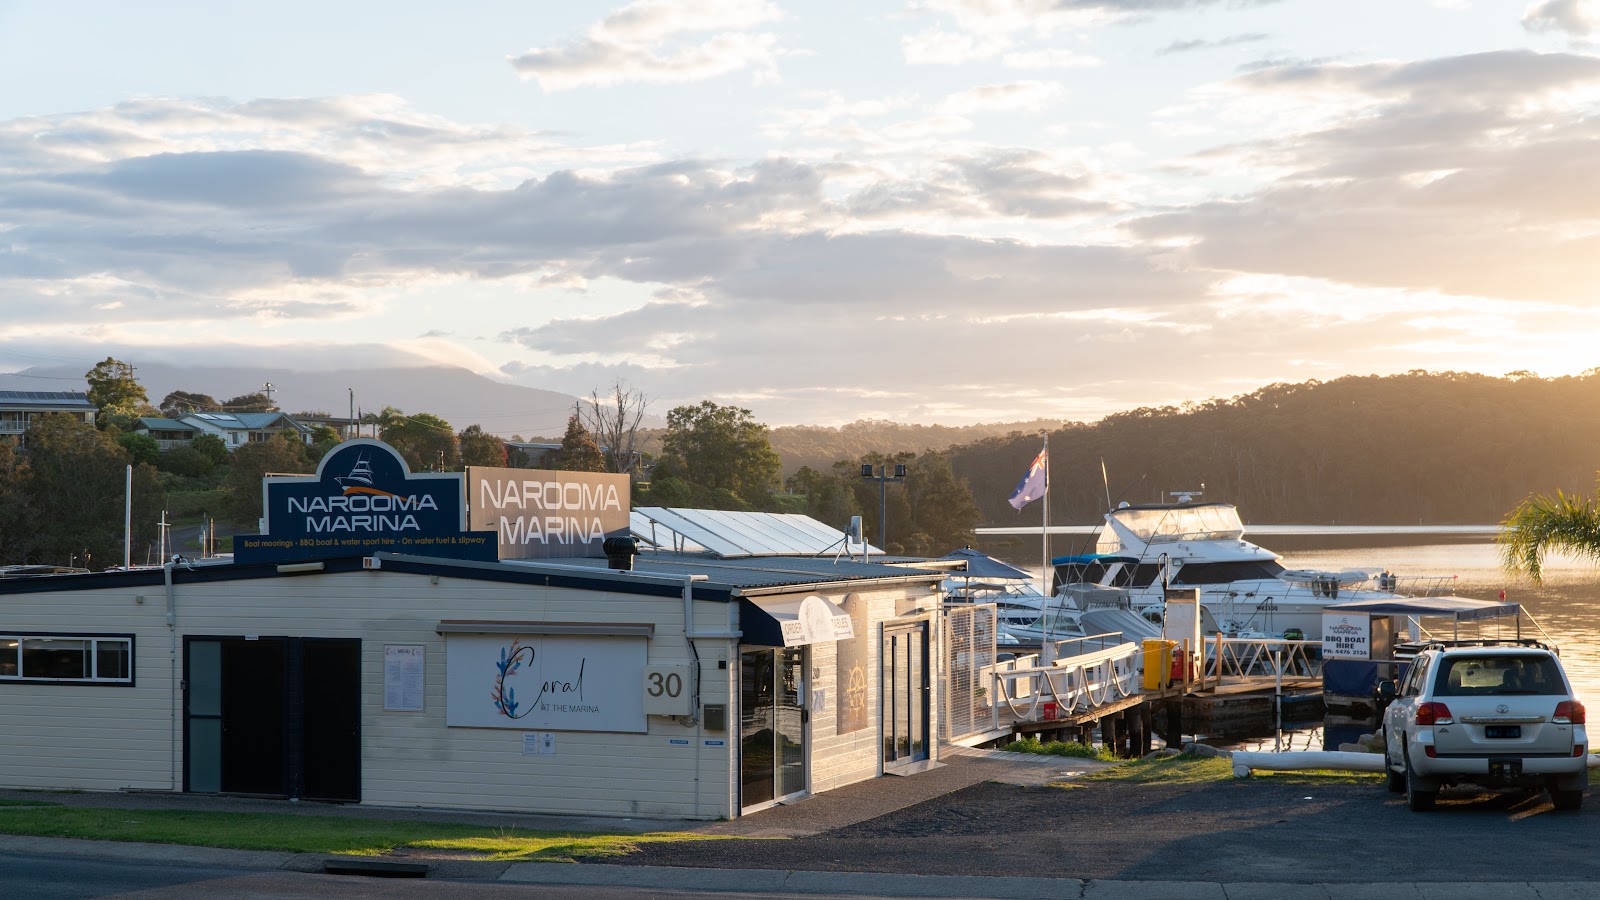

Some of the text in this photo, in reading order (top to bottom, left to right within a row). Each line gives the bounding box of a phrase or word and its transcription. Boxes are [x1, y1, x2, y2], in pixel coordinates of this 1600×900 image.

[287, 494, 438, 513] NAROOMA
[480, 479, 621, 511] NAROOMA
[306, 515, 420, 532] MARINA
[500, 516, 606, 545] MARINA
[261, 539, 293, 548] moorings
[363, 538, 380, 546] sport
[458, 536, 486, 545] slipway
[784, 622, 804, 635] ORDER
[500, 646, 586, 719] Coral
[647, 672, 683, 698] 30
[569, 705, 599, 713] MARINA
